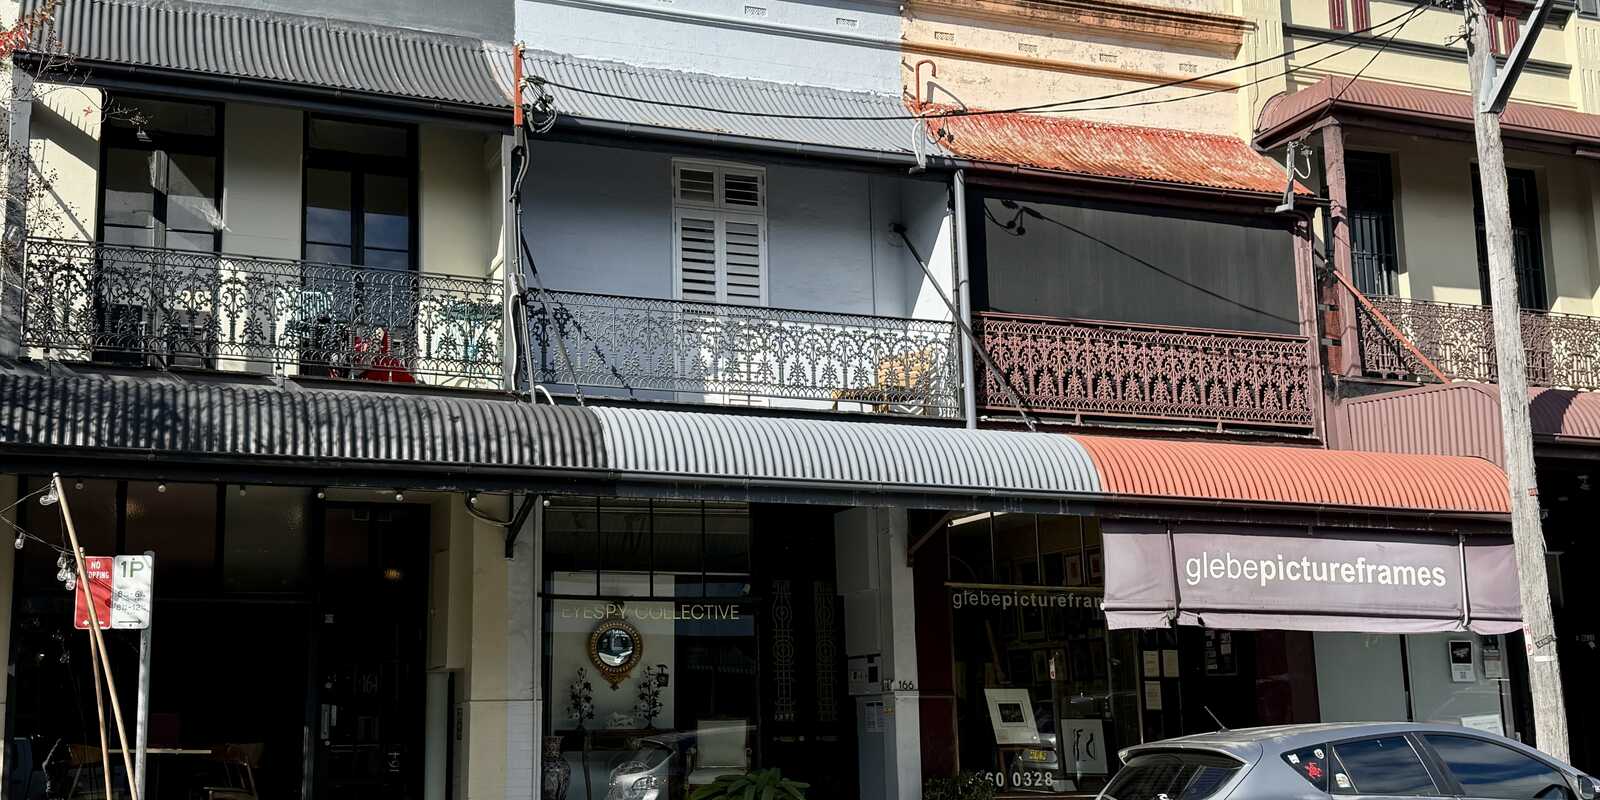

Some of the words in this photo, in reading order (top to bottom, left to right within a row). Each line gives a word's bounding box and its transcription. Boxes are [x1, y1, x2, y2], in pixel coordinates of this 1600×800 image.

[91, 560, 101, 570] NO
[120, 560, 144, 578] 1P
[1185, 551, 1446, 586] glebepictureframes
[87, 570, 110, 579] OPPING
[561, 603, 627, 621] EYESPY
[635, 604, 740, 621] COLLECTIVE
[898, 680, 914, 690] 166
[1012, 771, 1053, 787] 0328
